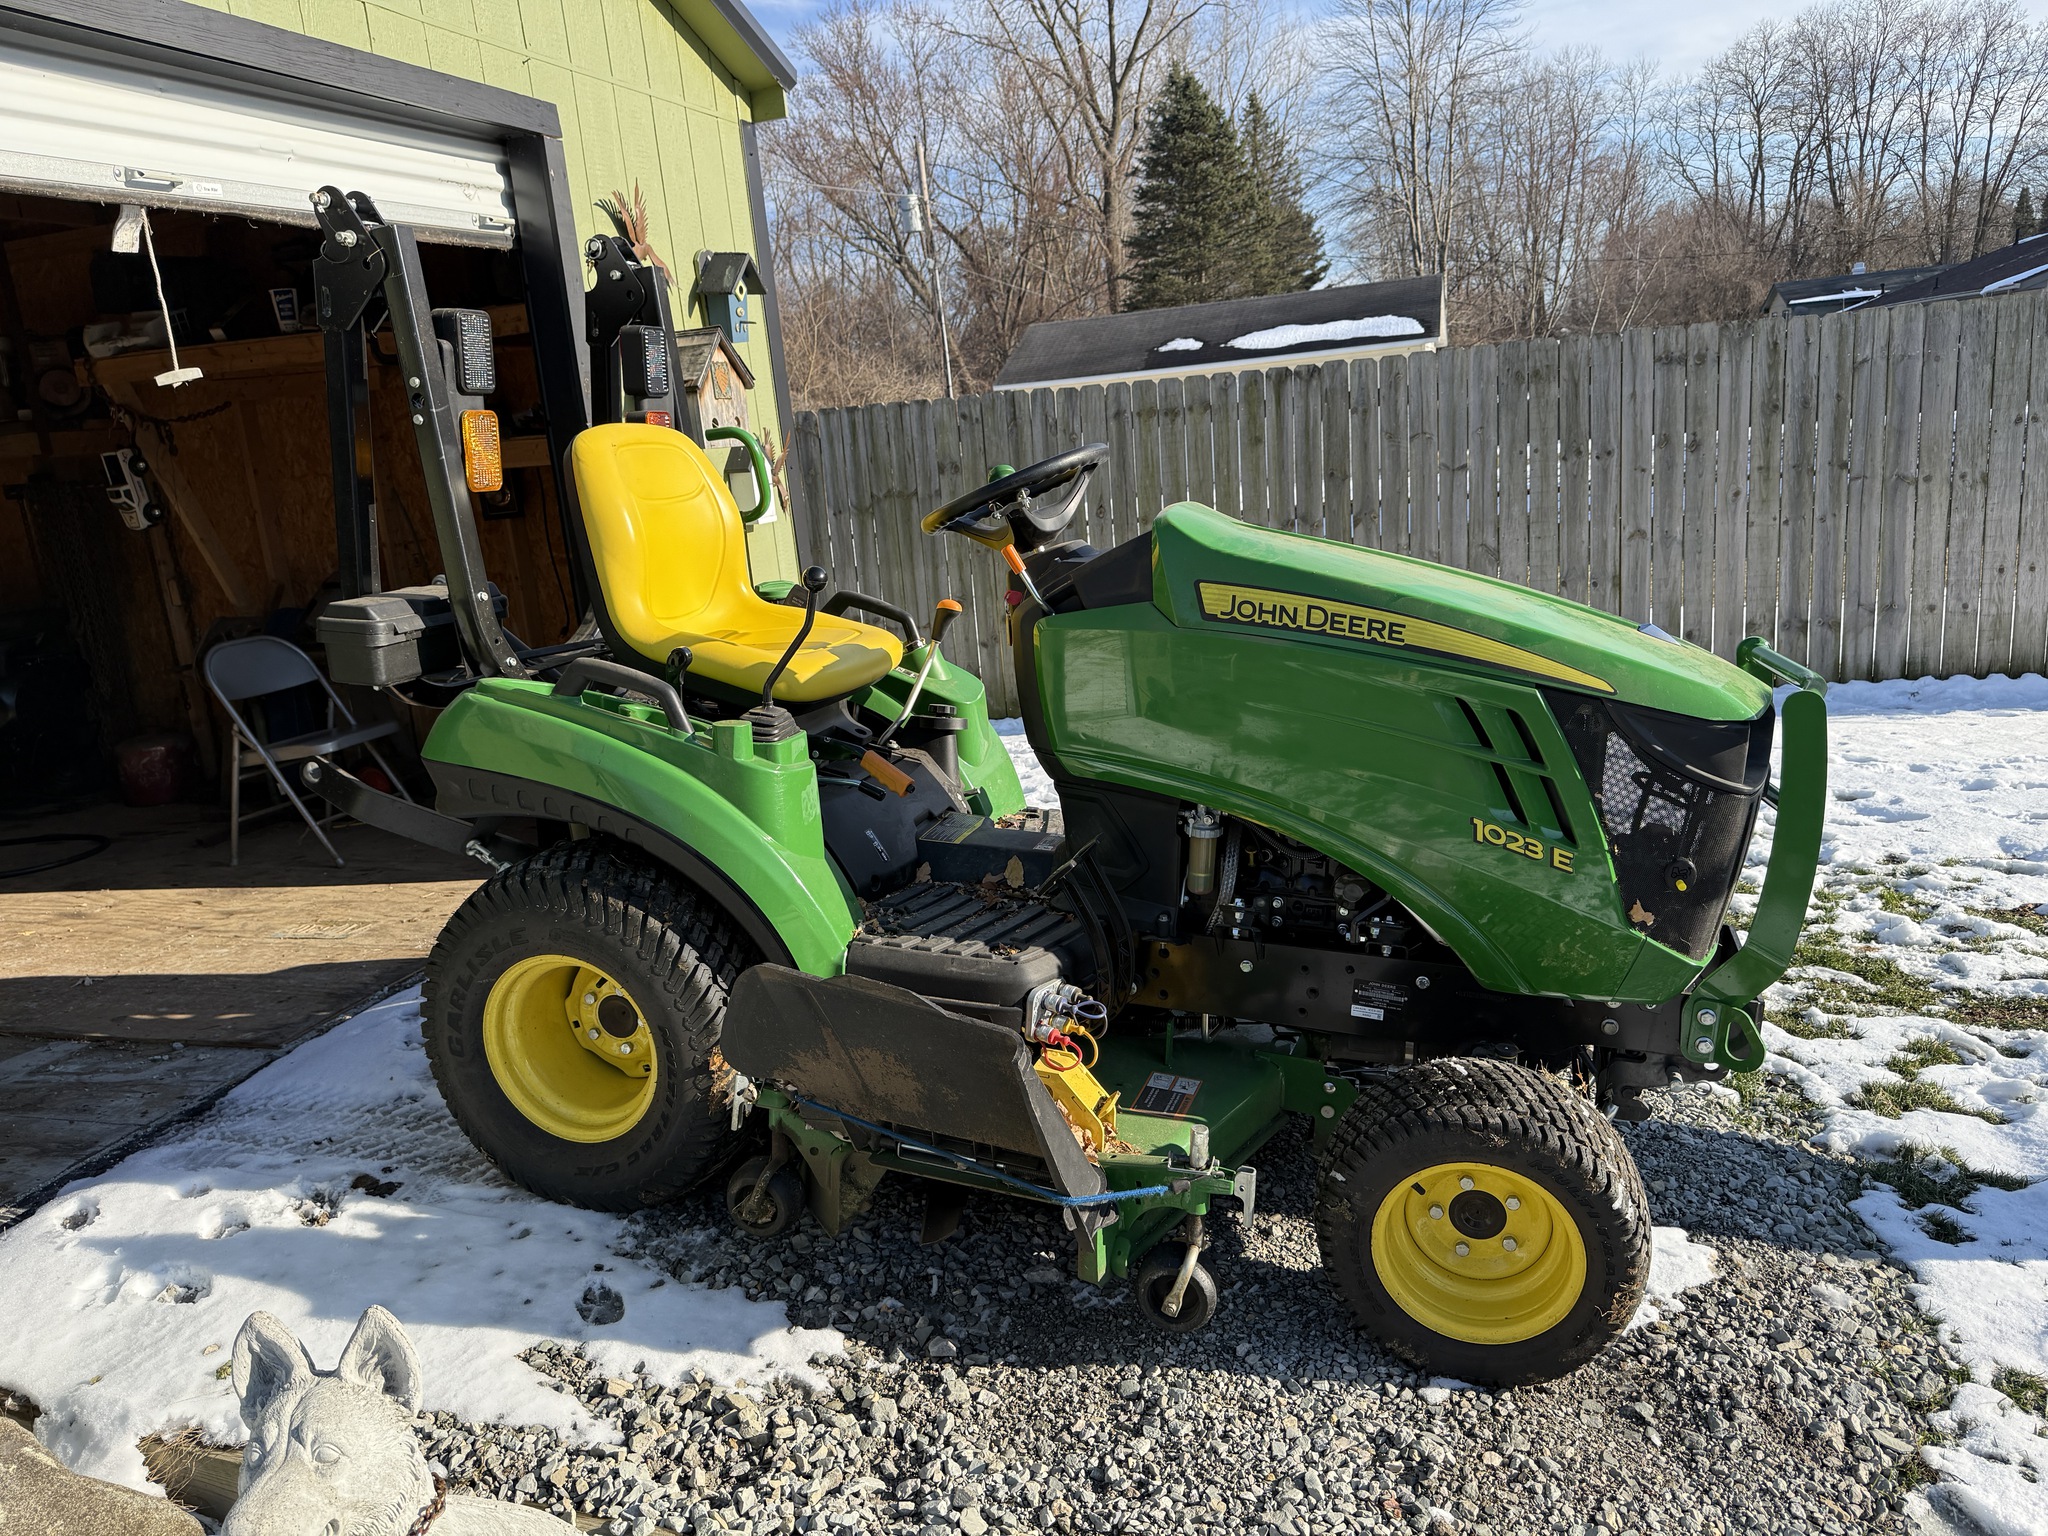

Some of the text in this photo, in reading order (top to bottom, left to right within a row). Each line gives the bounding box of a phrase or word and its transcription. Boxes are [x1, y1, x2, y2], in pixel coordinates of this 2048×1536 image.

[1219, 594, 1407, 644] JOHN DEERE
[1470, 816, 1575, 874] 1023 E
[446, 926, 529, 1058] CARLISLE
[658, 1024, 678, 1108] MULTI
[627, 1111, 670, 1167] TRAC
[1527, 1159, 1601, 1219] MULTI
